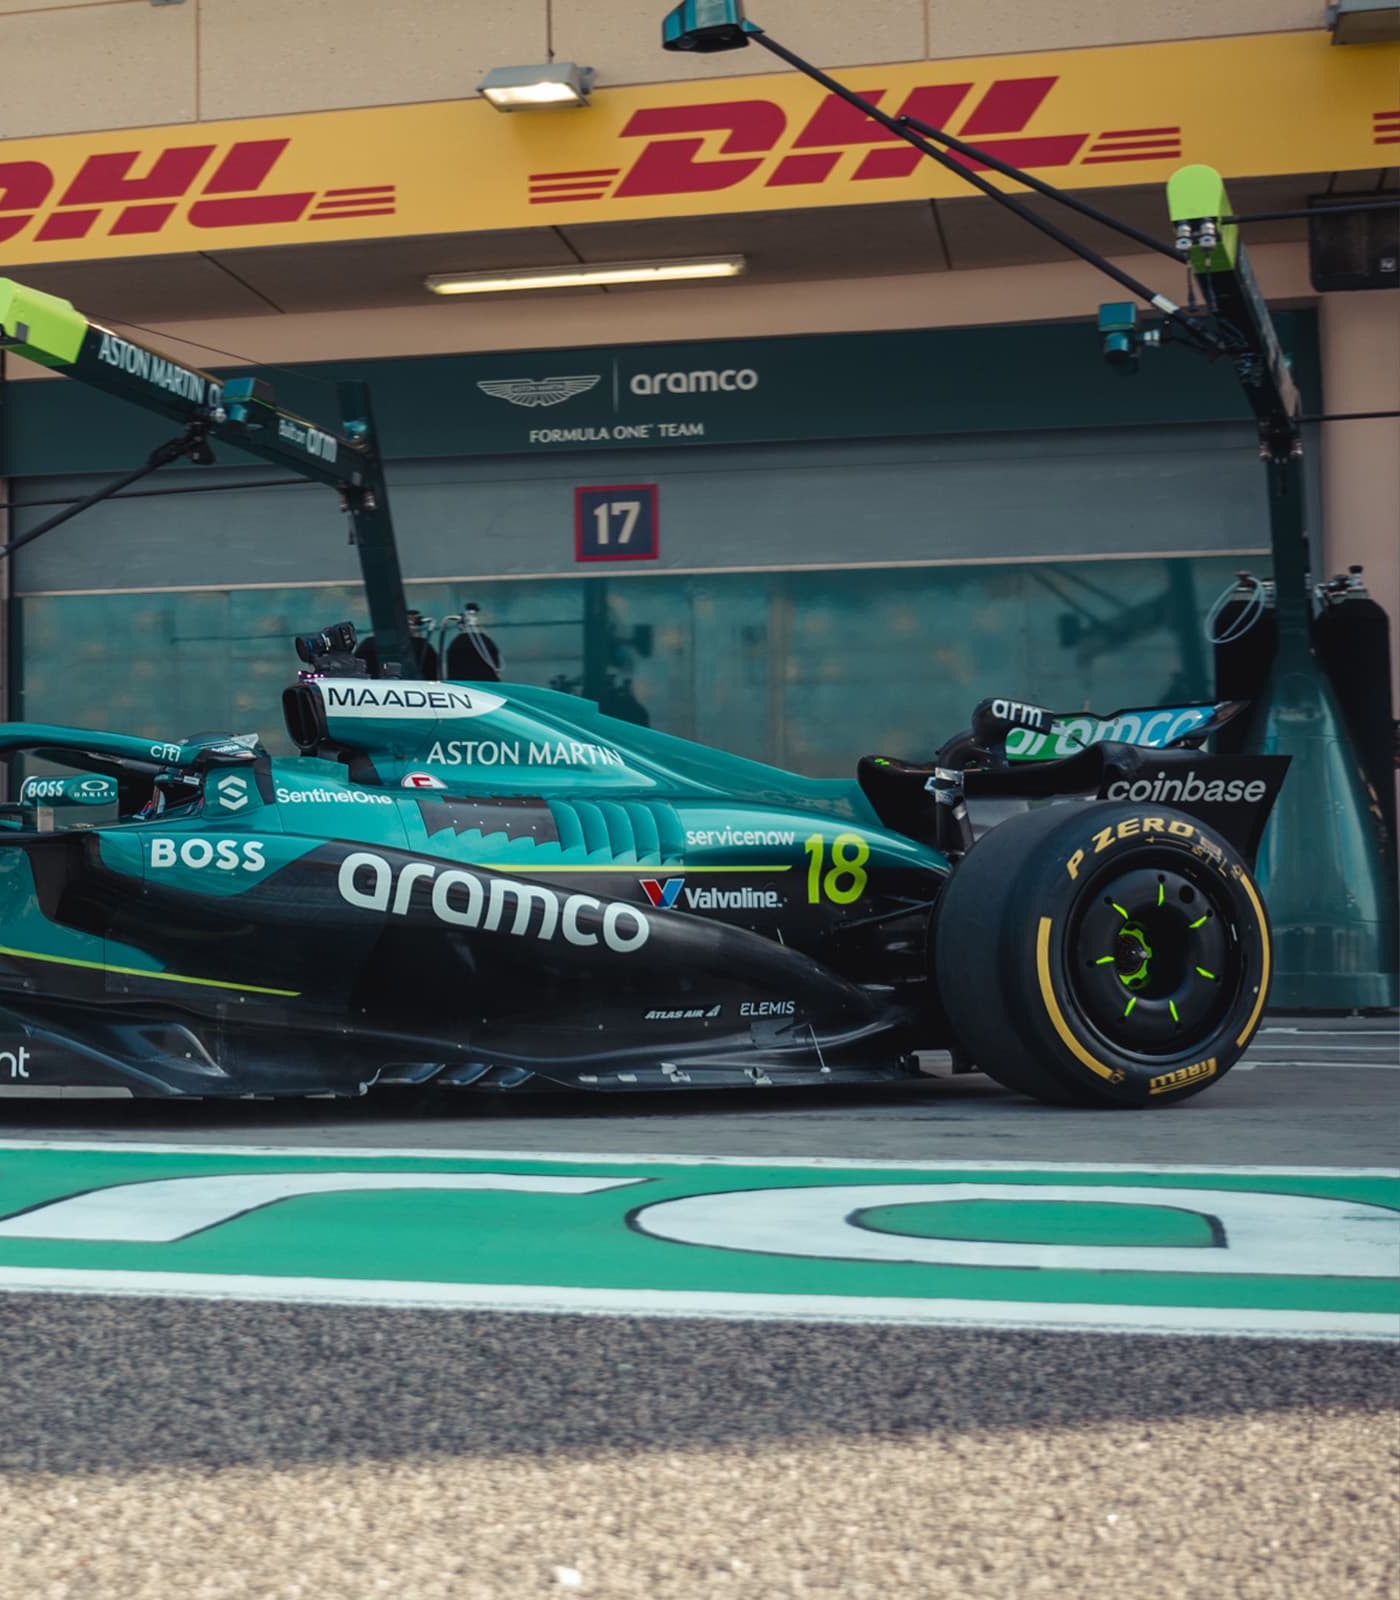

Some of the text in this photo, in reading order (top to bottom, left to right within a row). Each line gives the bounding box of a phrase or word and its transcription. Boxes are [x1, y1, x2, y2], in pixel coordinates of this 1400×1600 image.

[611, 76, 1091, 199] DHL
[98, 334, 151, 383] ASTON
[149, 353, 205, 404] MARTIN
[630, 368, 758, 395] aramco
[529, 429, 610, 443] FORMULA
[657, 423, 704, 437] TEAM
[593, 501, 641, 545] 17
[328, 687, 473, 710] MAADEN
[991, 699, 1043, 728] arm
[150, 743, 182, 763] citi
[426, 741, 625, 767] ASTON MARTIN
[27, 779, 64, 798] BOSS
[74, 791, 115, 799] OAKLEY
[276, 787, 393, 805] SentinelOne
[1107, 771, 1266, 802] coinbase
[686, 825, 795, 846] servicenow
[1066, 847, 1085, 881] P
[1092, 817, 1196, 854] ZERO
[151, 838, 266, 873] BOSS
[804, 832, 870, 905] 18
[338, 851, 650, 953] aramco
[644, 1009, 704, 1020] ATLAS AIR
[739, 1001, 796, 1016] ELEMIS
[1150, 1056, 1218, 1095] PIRELLI
